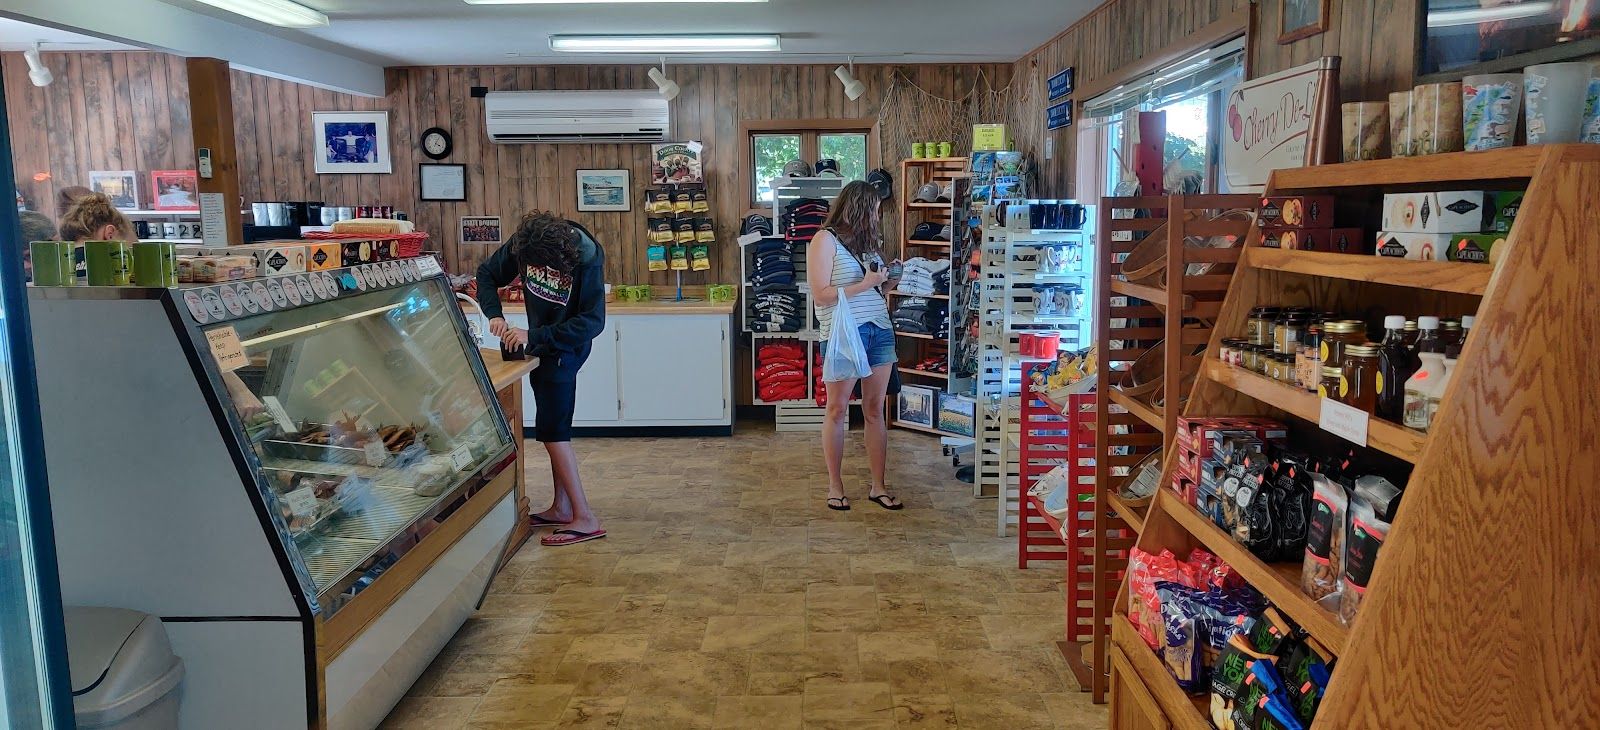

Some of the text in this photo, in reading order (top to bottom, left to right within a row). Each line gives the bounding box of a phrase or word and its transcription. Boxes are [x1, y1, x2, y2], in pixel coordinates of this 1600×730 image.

[1243, 107, 1279, 151] Cherry
[537, 270, 559, 290] VANS
[1223, 664, 1245, 686] YOR
